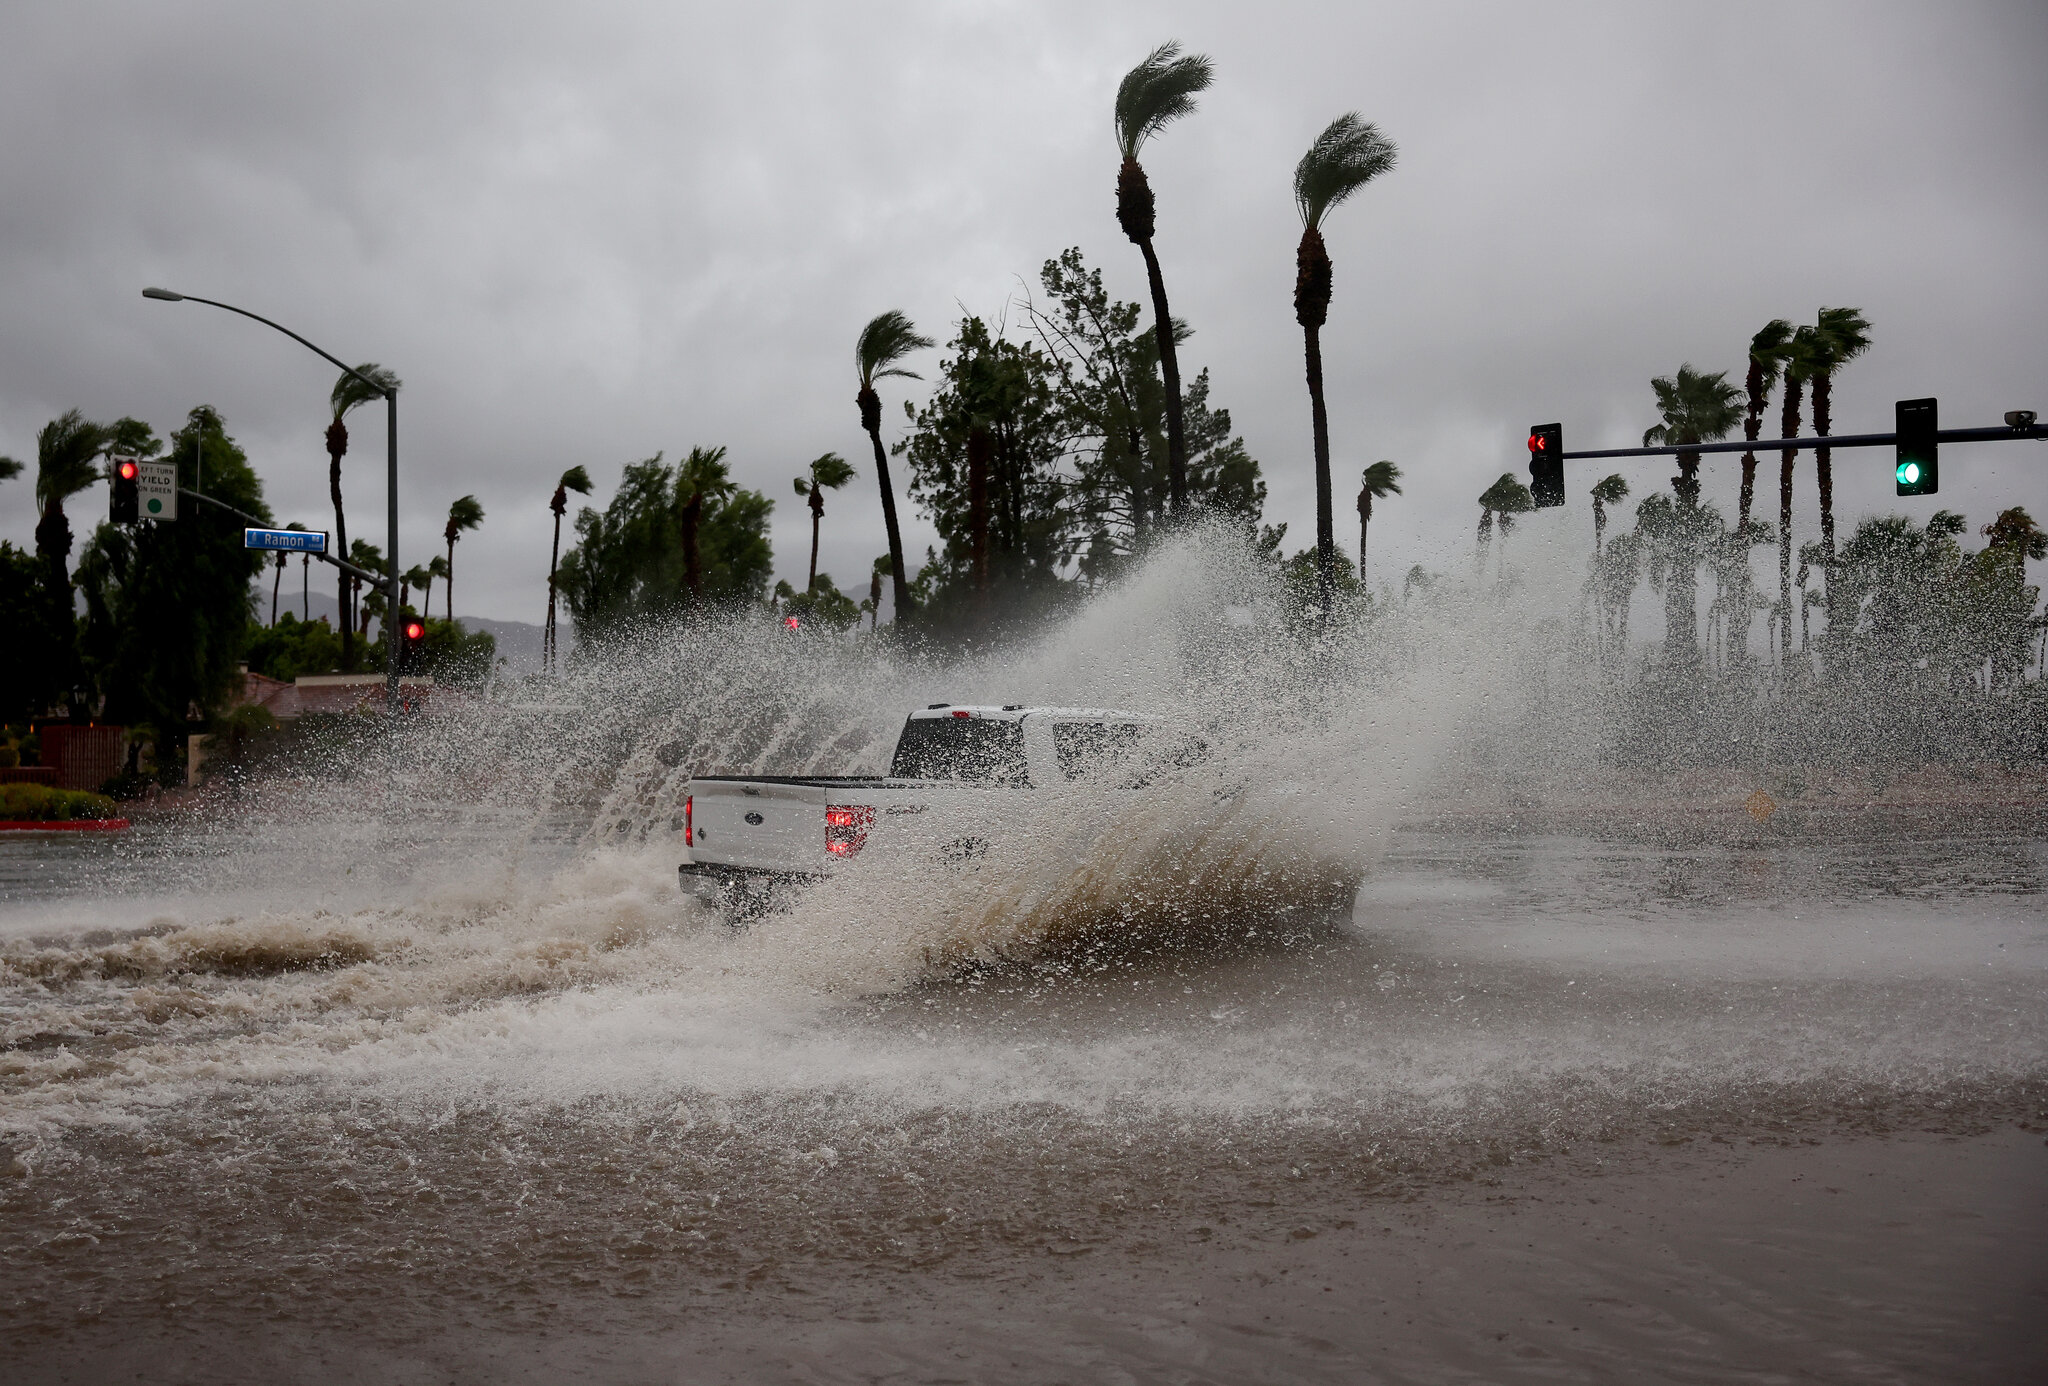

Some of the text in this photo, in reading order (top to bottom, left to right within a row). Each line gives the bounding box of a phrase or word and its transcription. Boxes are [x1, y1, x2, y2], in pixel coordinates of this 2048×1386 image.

[157, 467, 173, 475] TURN
[141, 476, 170, 485] YIELD
[150, 486, 171, 494] GREEN
[265, 533, 304, 547] Ramon
